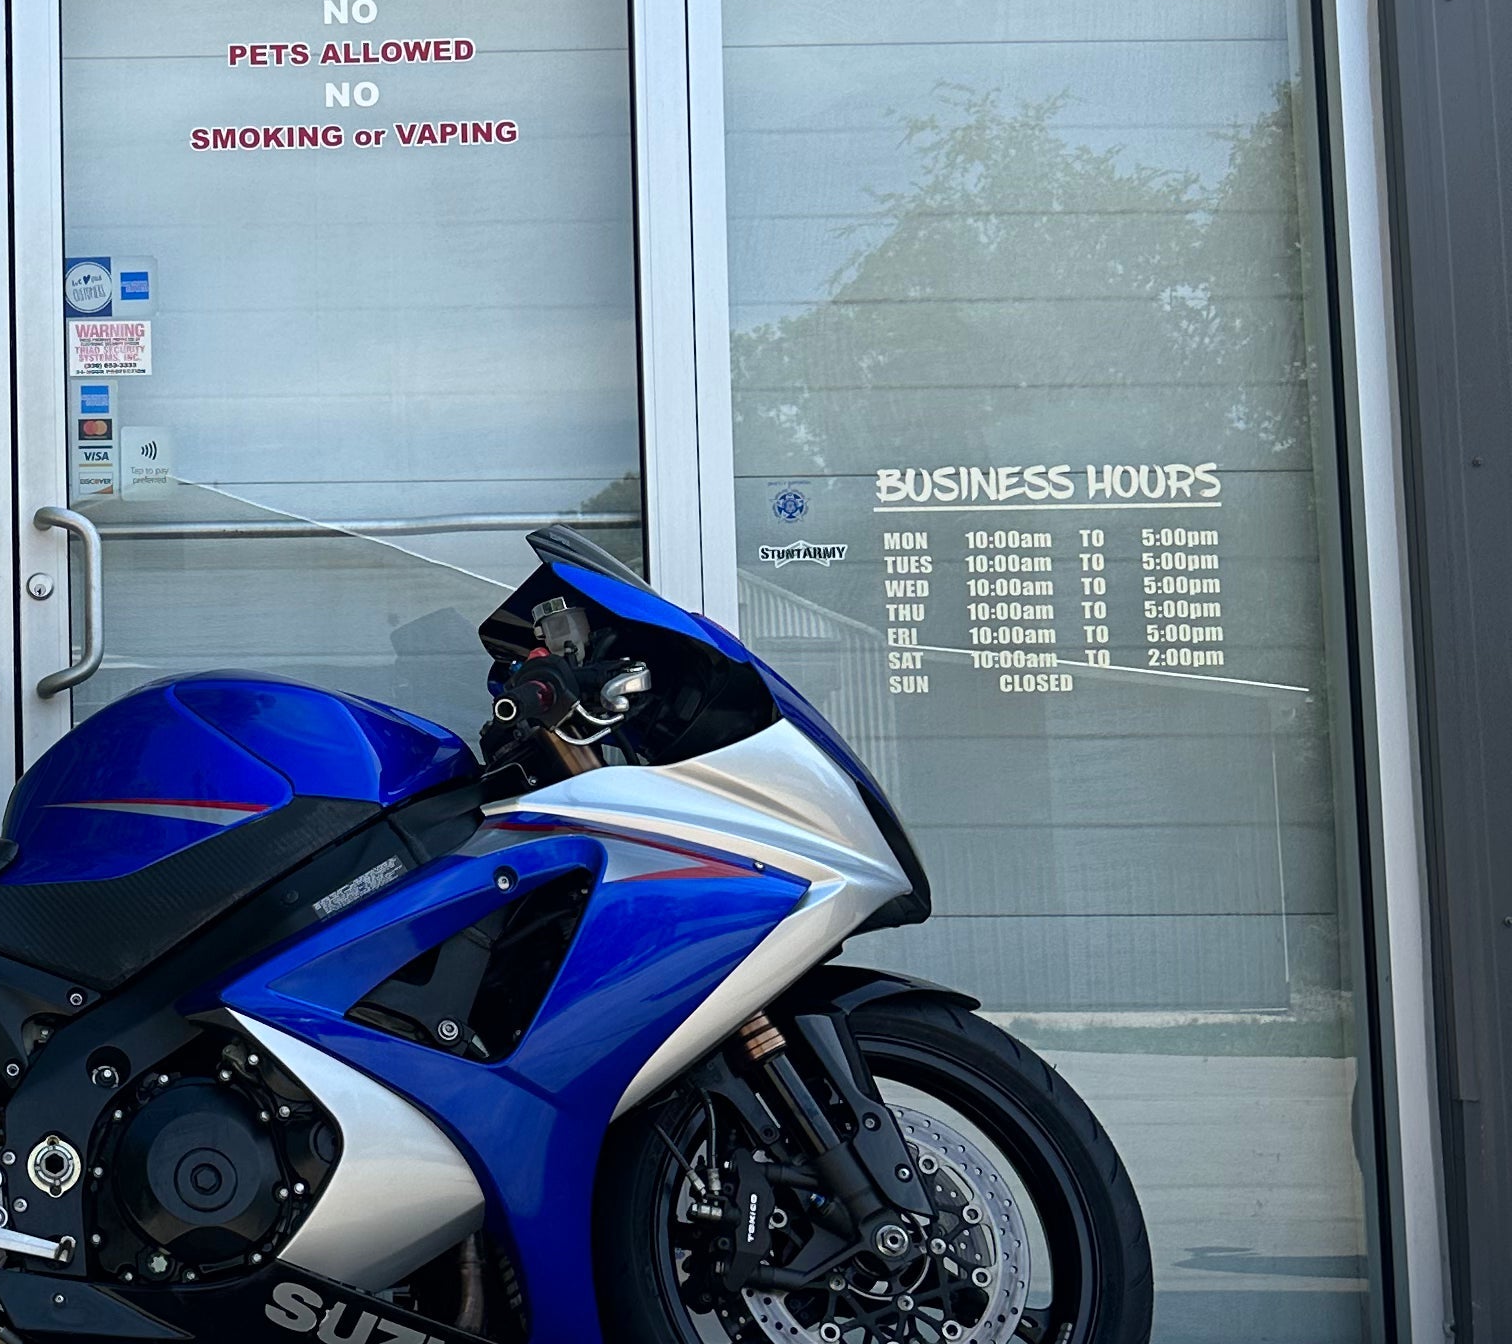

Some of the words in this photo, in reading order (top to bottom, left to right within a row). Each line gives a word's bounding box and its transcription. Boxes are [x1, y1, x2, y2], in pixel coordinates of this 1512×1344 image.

[228, 43, 310, 67] PETS
[319, 39, 475, 65] ALLOWED
[324, 81, 380, 107] NO
[190, 126, 344, 150] SMOKING
[354, 130, 386, 147] or
[395, 120, 519, 146] VAPING
[75, 323, 145, 338] WARNING
[84, 451, 110, 461] VISA
[875, 464, 1076, 503] BUSINESS
[1086, 462, 1222, 500] HOURS
[883, 532, 929, 550] MON
[964, 530, 1052, 549] 10:00am
[1079, 529, 1105, 547] TO
[1141, 528, 1219, 547] 5:00pm
[760, 546, 846, 560] STUNTARMY
[884, 556, 933, 574] TUES
[965, 554, 1053, 573] 10:00am
[1079, 553, 1106, 571] TO
[1142, 552, 1220, 571] 5:00pm
[884, 580, 930, 598] WED
[966, 578, 1054, 597] 10:00am
[1080, 577, 1107, 595] TO
[1143, 576, 1221, 595] 5:00pm
[885, 604, 925, 622] THU
[967, 602, 1055, 621] 10:00am
[1081, 601, 1108, 619] TO
[1144, 600, 1222, 619] 5:00pm
[887, 628, 918, 646] FRI
[969, 626, 1057, 645] 10:00am
[1083, 625, 1110, 643] TO
[1146, 624, 1224, 643] 5:00pm
[888, 651, 924, 669] SAT
[971, 650, 1058, 668] 10:00am
[1084, 649, 1111, 667] TO
[1147, 648, 1225, 667] 2:00pm
[889, 675, 929, 693] SUN
[999, 674, 1074, 692] CLOSED
